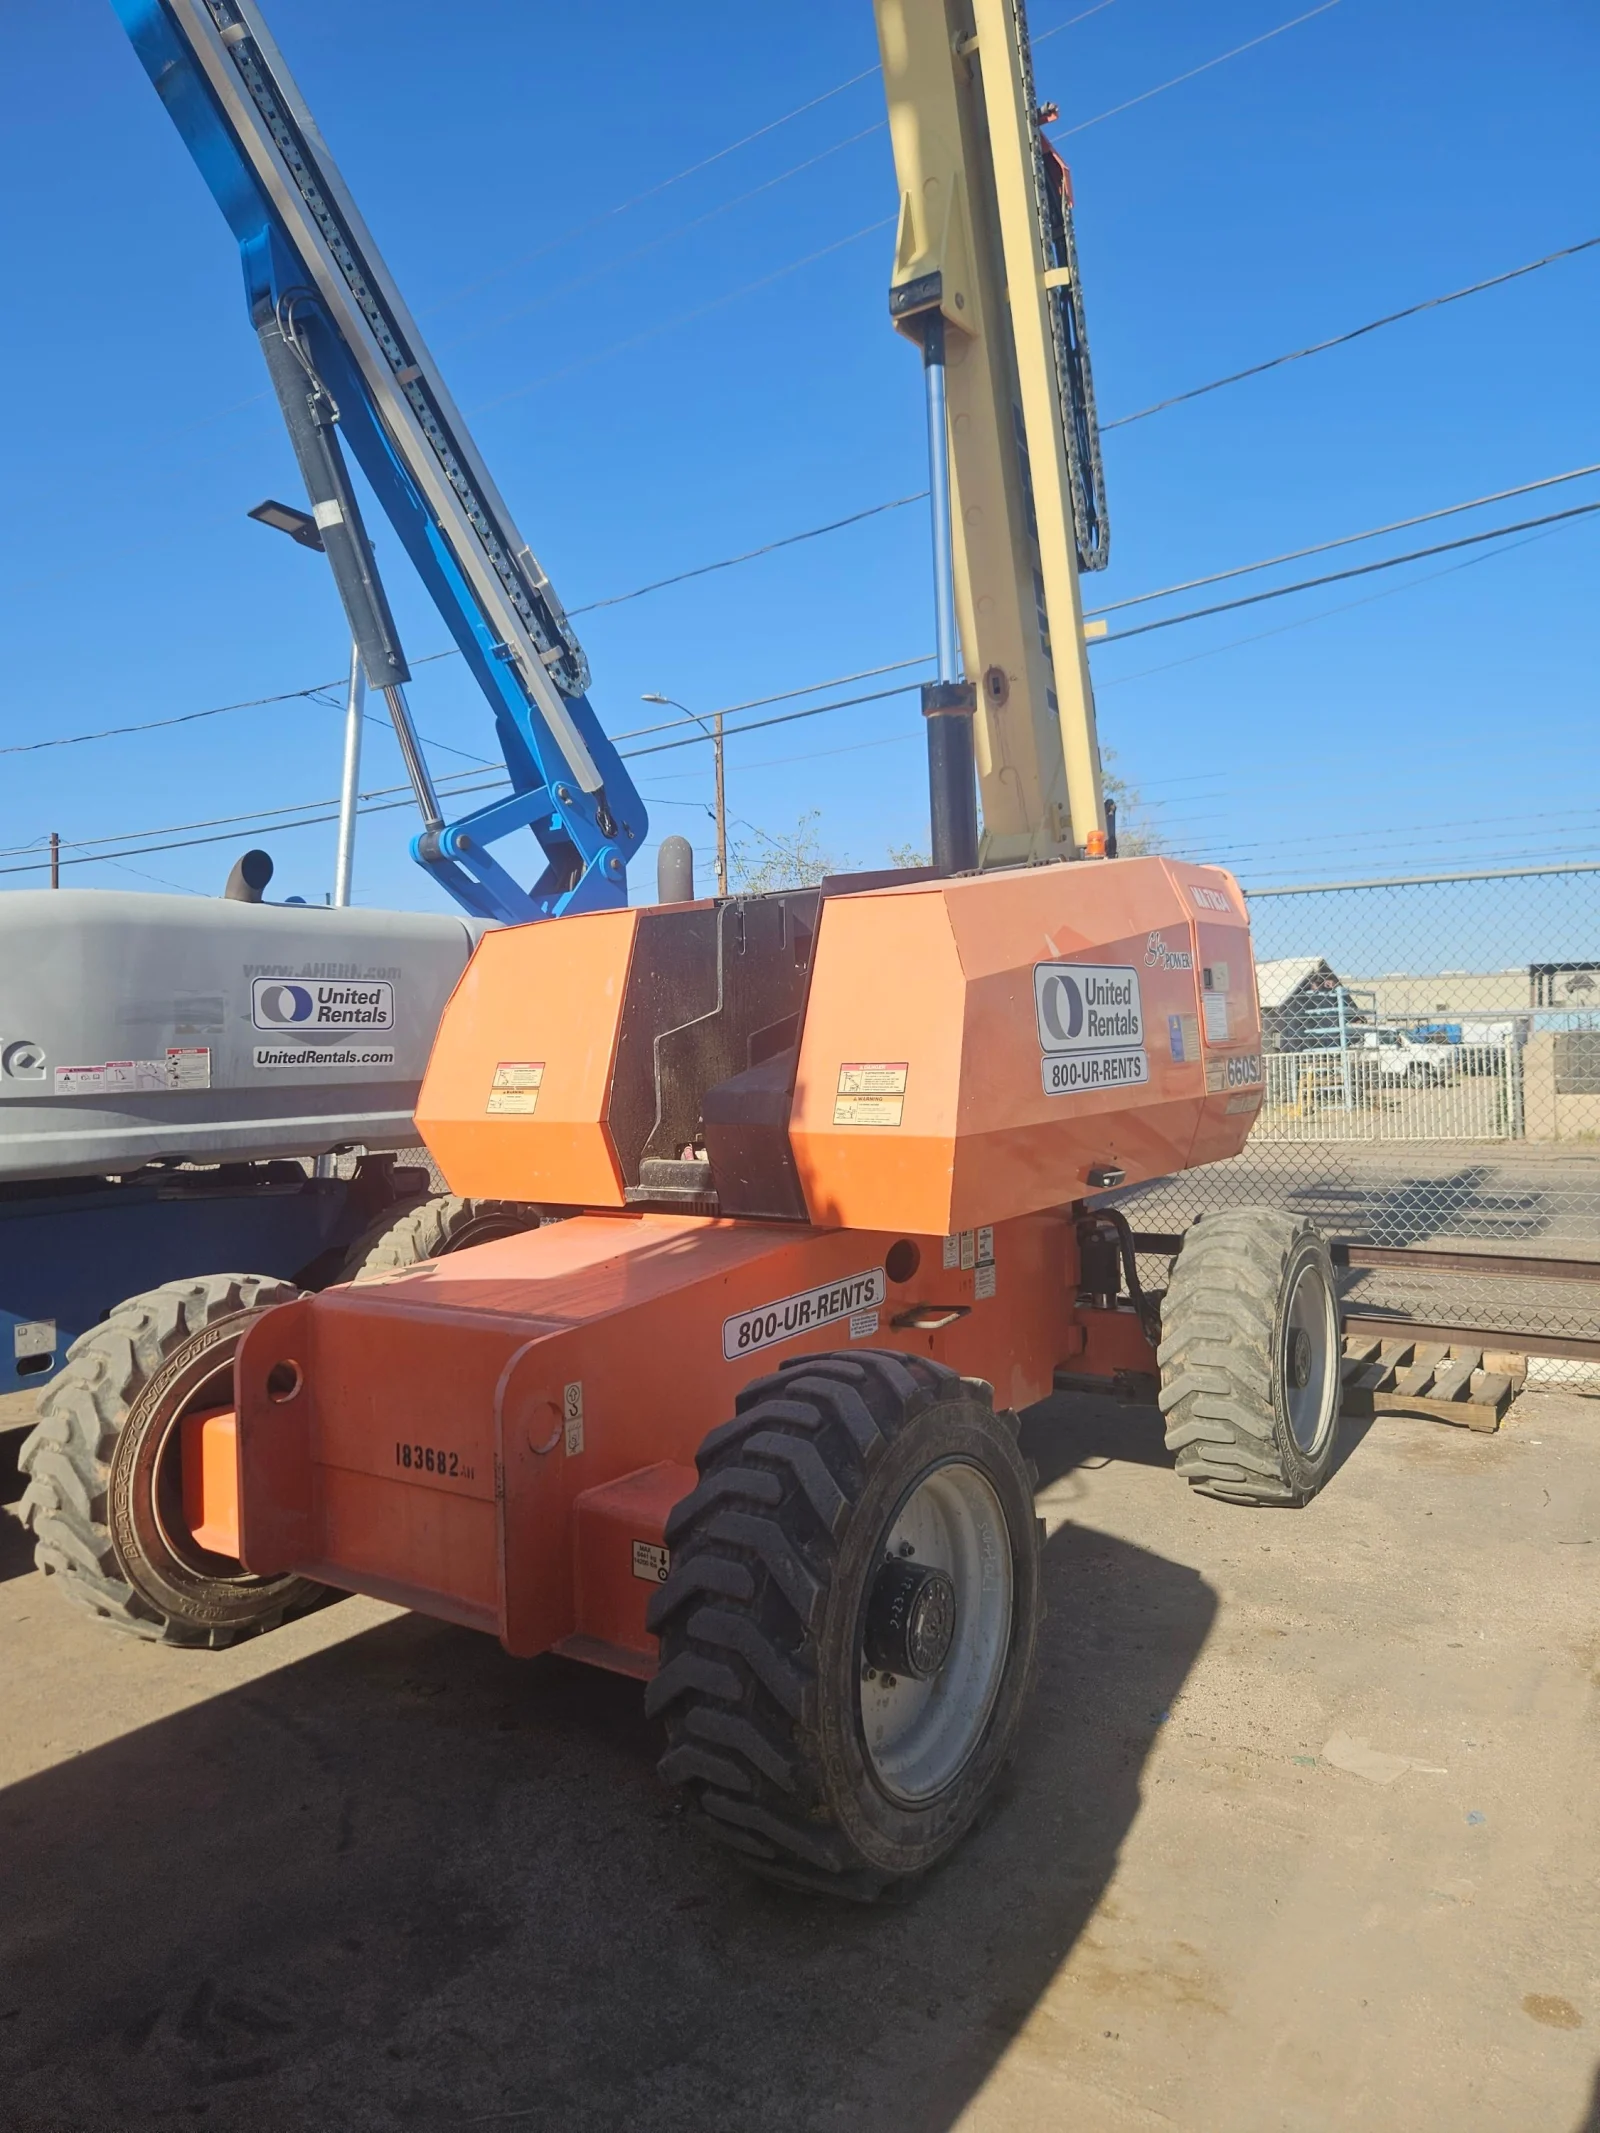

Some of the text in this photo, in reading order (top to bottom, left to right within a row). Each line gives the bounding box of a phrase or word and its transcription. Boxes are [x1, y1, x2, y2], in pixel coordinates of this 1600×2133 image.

[1164, 952, 1190, 969] POWER
[317, 987, 381, 1004] United
[1085, 978, 1132, 1005] United
[317, 1006, 387, 1023] Rentals
[1087, 1008, 1138, 1037] Rentals
[256, 1050, 393, 1064] UnitedRentals.com
[1052, 1056, 1141, 1087] 800-UR-RENTS
[738, 1278, 875, 1348] 800-UR-RENTS
[396, 1442, 459, 1477] 183682
